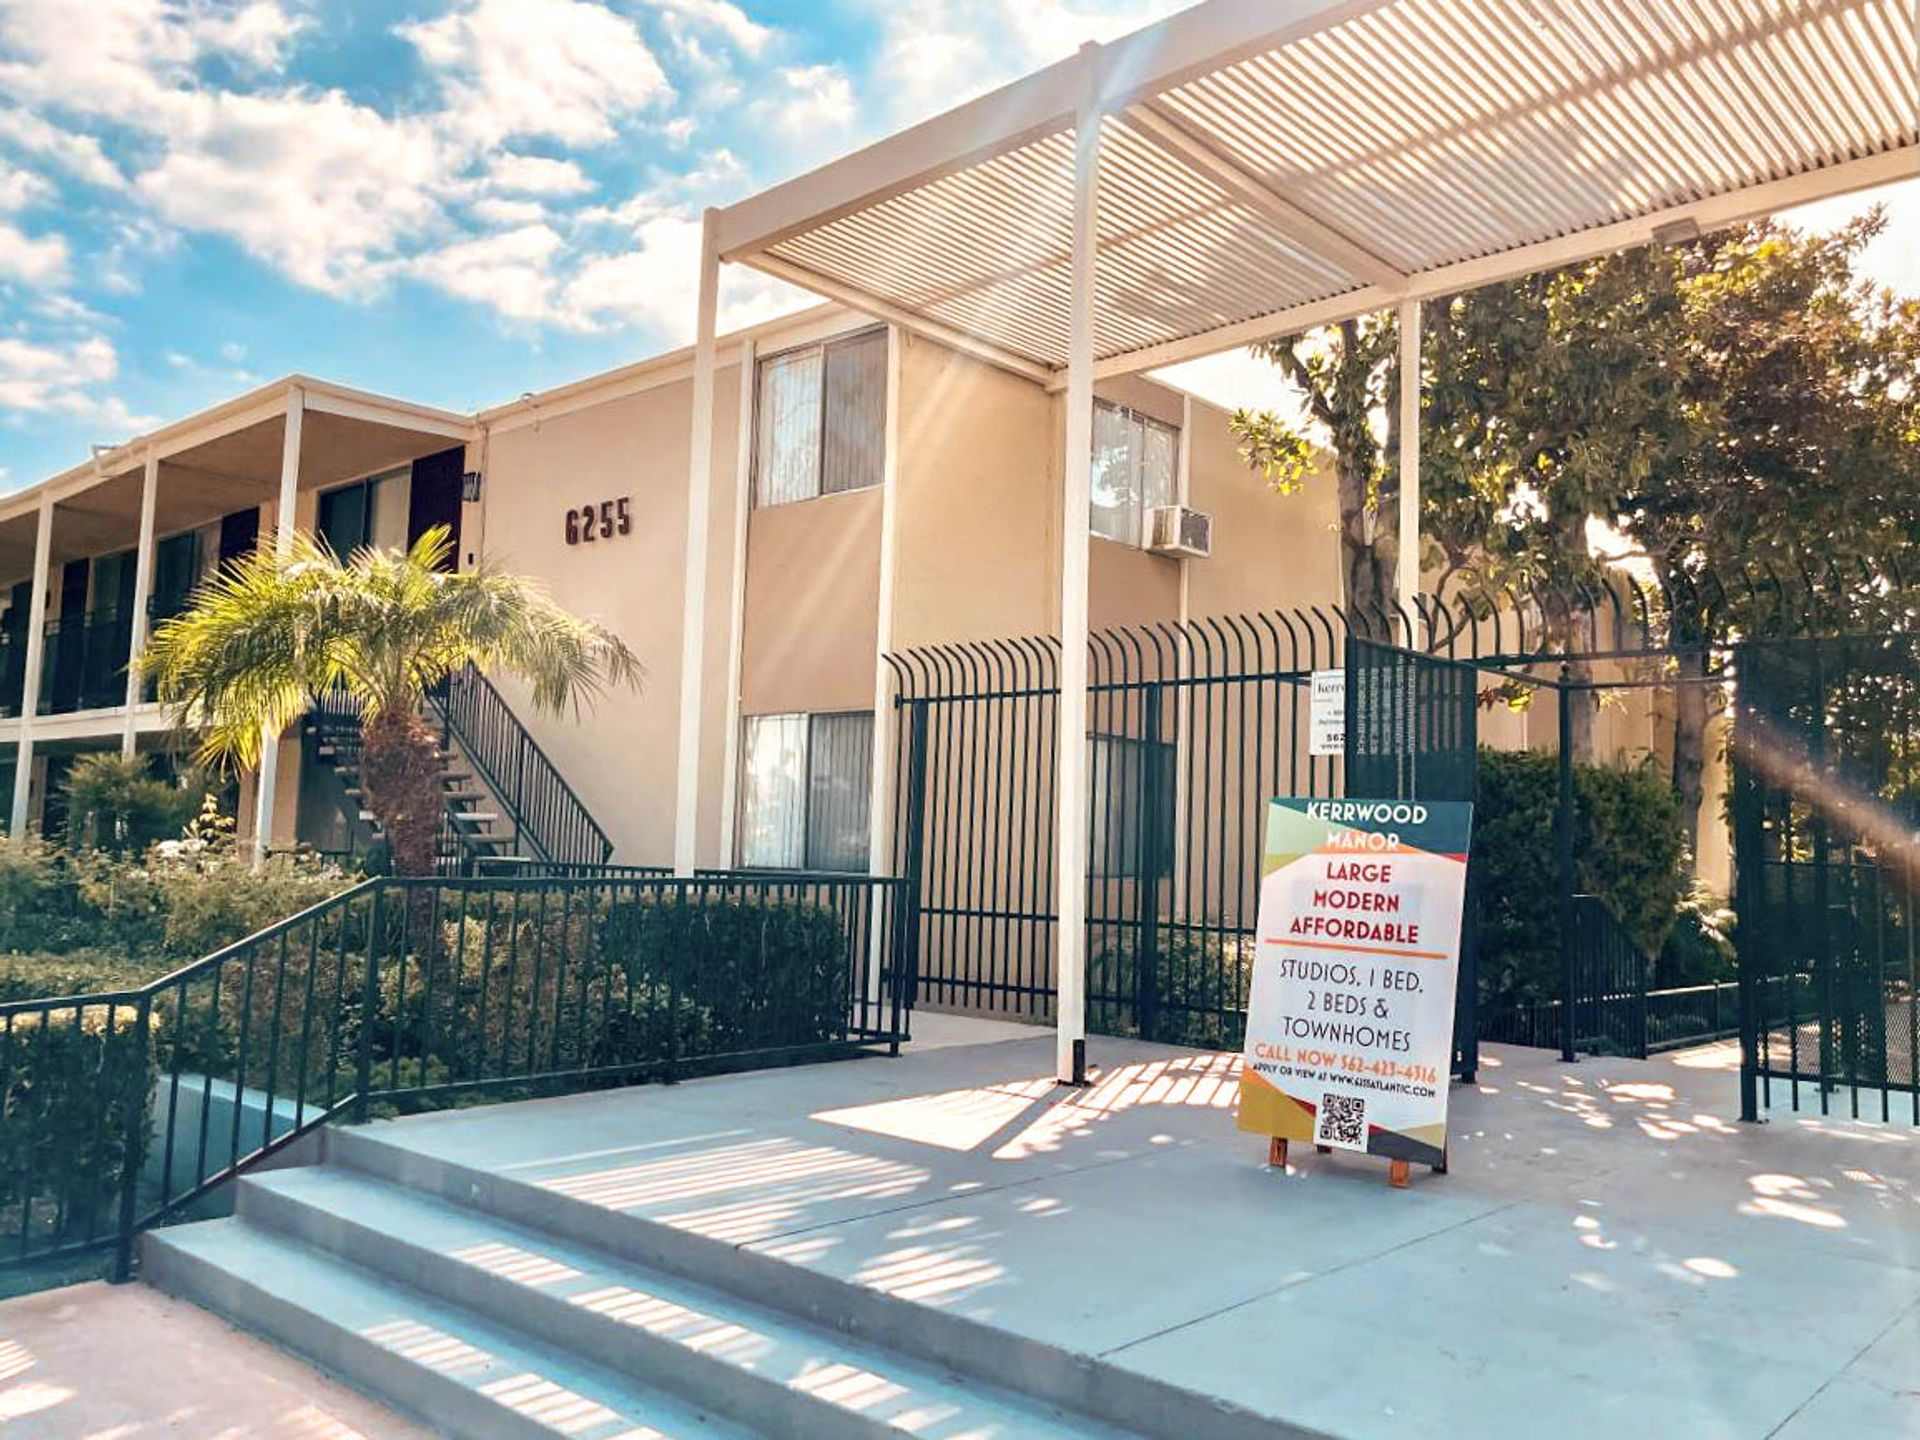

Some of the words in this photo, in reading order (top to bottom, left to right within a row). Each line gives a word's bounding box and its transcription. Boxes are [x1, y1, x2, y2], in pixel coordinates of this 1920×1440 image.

[565, 497, 630, 546] 6255
[1306, 801, 1428, 825] KERRWOOD
[1326, 831, 1400, 852] MANOR
[1326, 861, 1392, 883] LARGE
[1312, 889, 1399, 912] MODERN
[1289, 916, 1419, 944] AFFORDABLE
[1307, 990, 1316, 1010] 2
[1323, 992, 1367, 1016] BEDS
[1374, 998, 1389, 1018] &
[1283, 1016, 1411, 1052] TOWNHOMES
[1255, 1043, 1292, 1061] CALL
[1297, 1048, 1337, 1067] NOW
[1253, 1063, 1278, 1073] APPLY
[1280, 1065, 1292, 1075] OR
[1296, 1069, 1316, 1079] VIEW
[1318, 1072, 1327, 1081] AT
